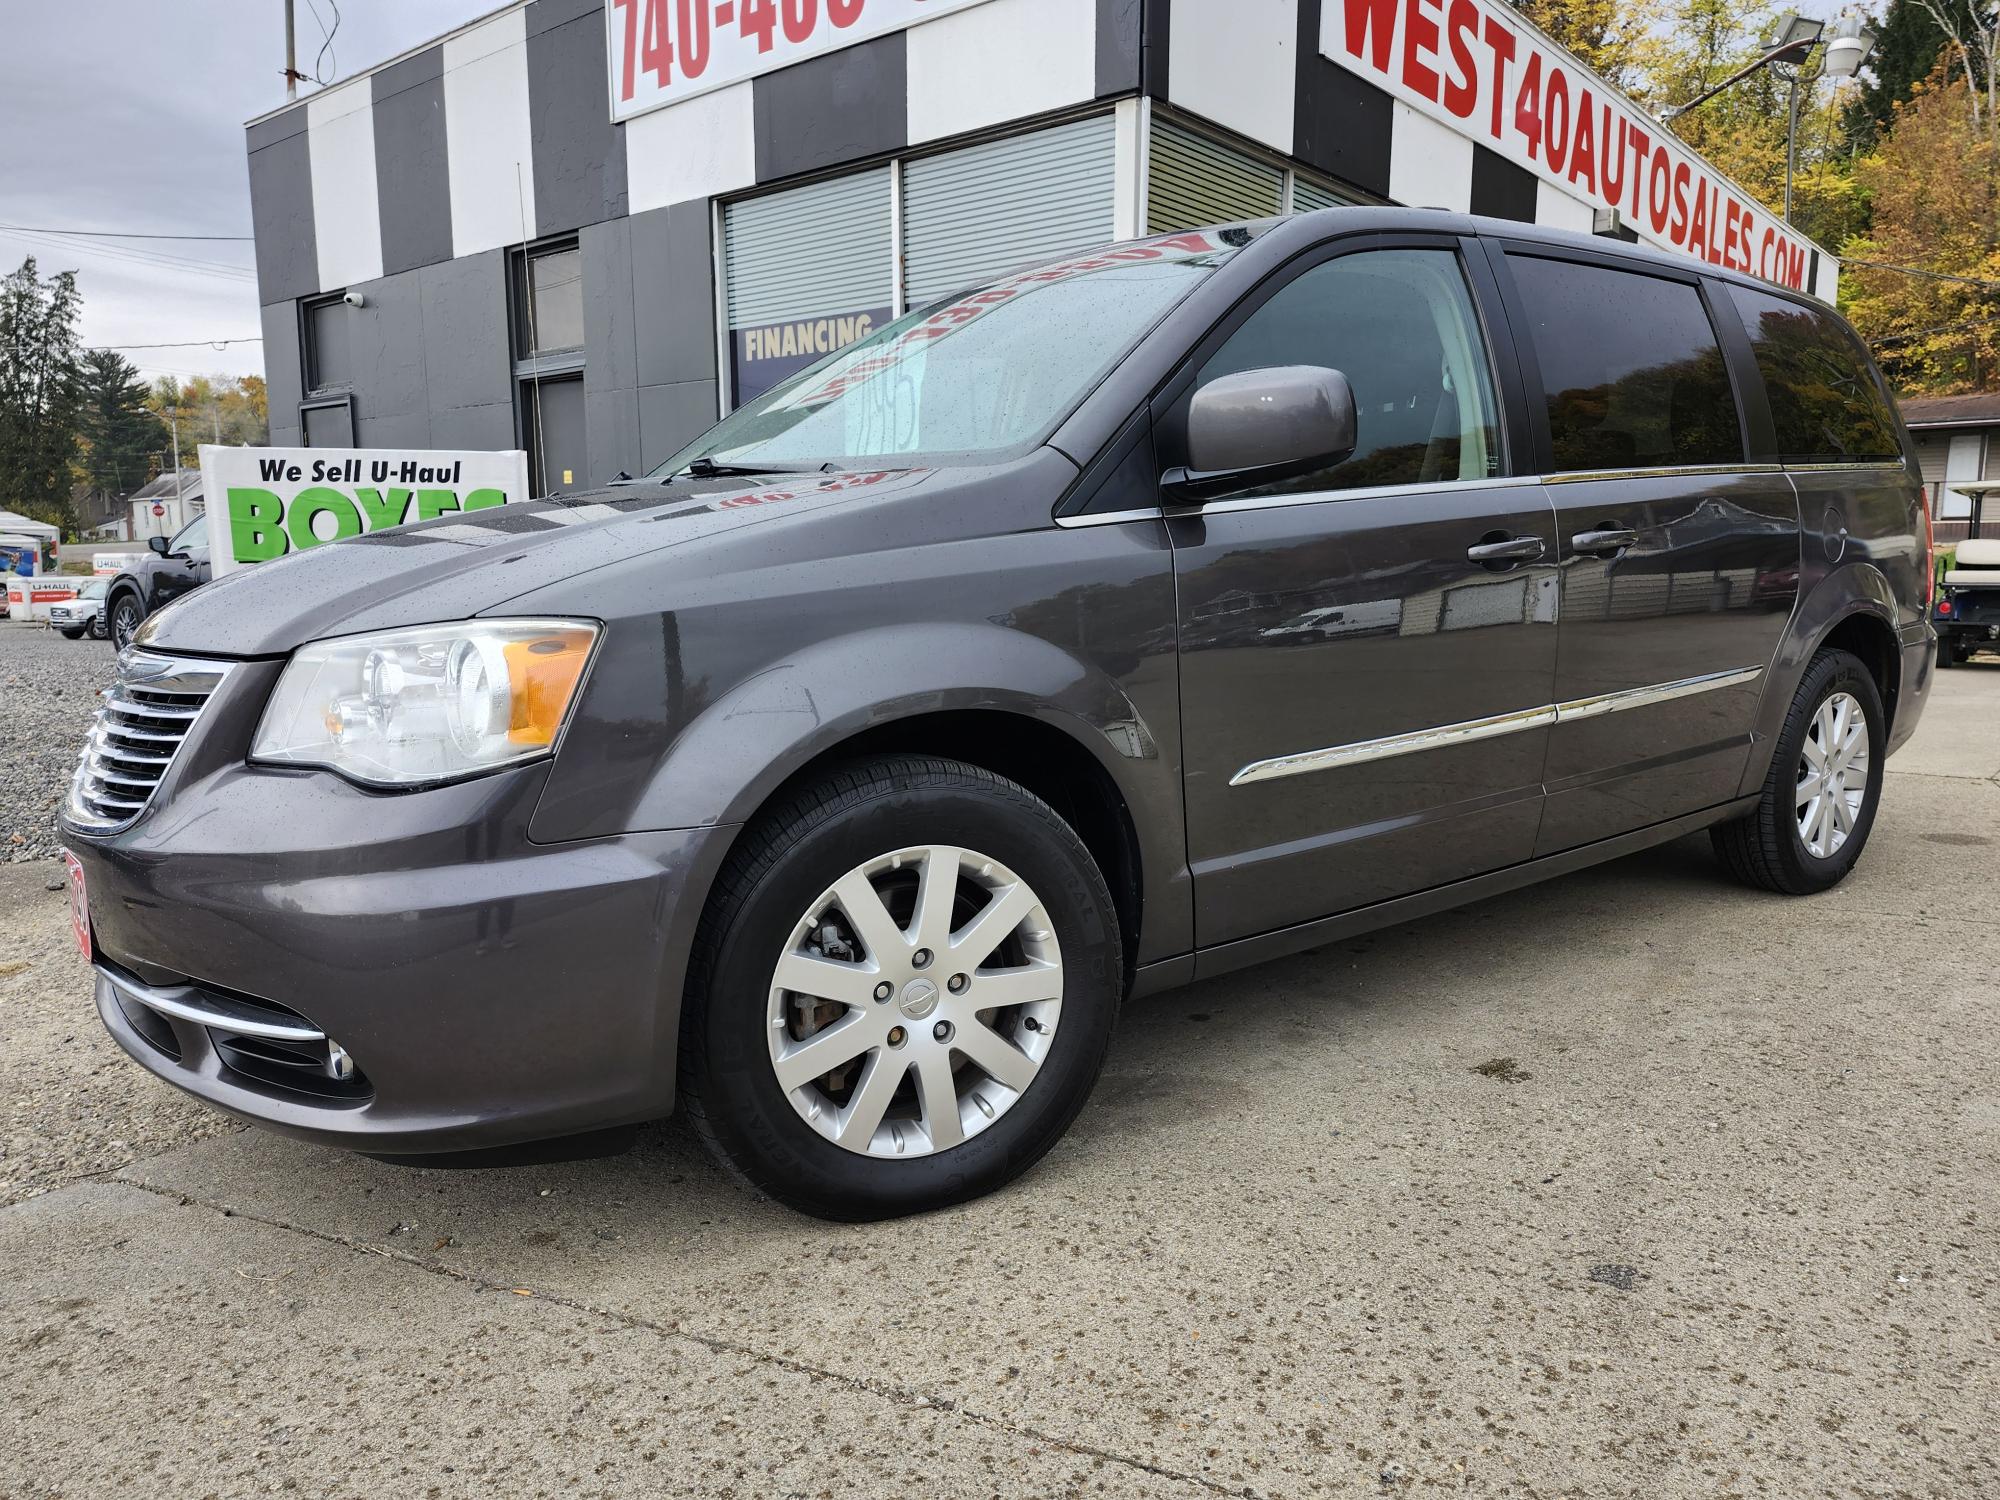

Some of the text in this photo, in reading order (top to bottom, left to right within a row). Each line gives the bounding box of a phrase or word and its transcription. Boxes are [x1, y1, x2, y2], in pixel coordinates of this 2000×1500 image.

[745, 314, 873, 362] FINANCING
[259, 459, 461, 483] We Sell U-Haul
[32, 583, 72, 591] U-HAUL
